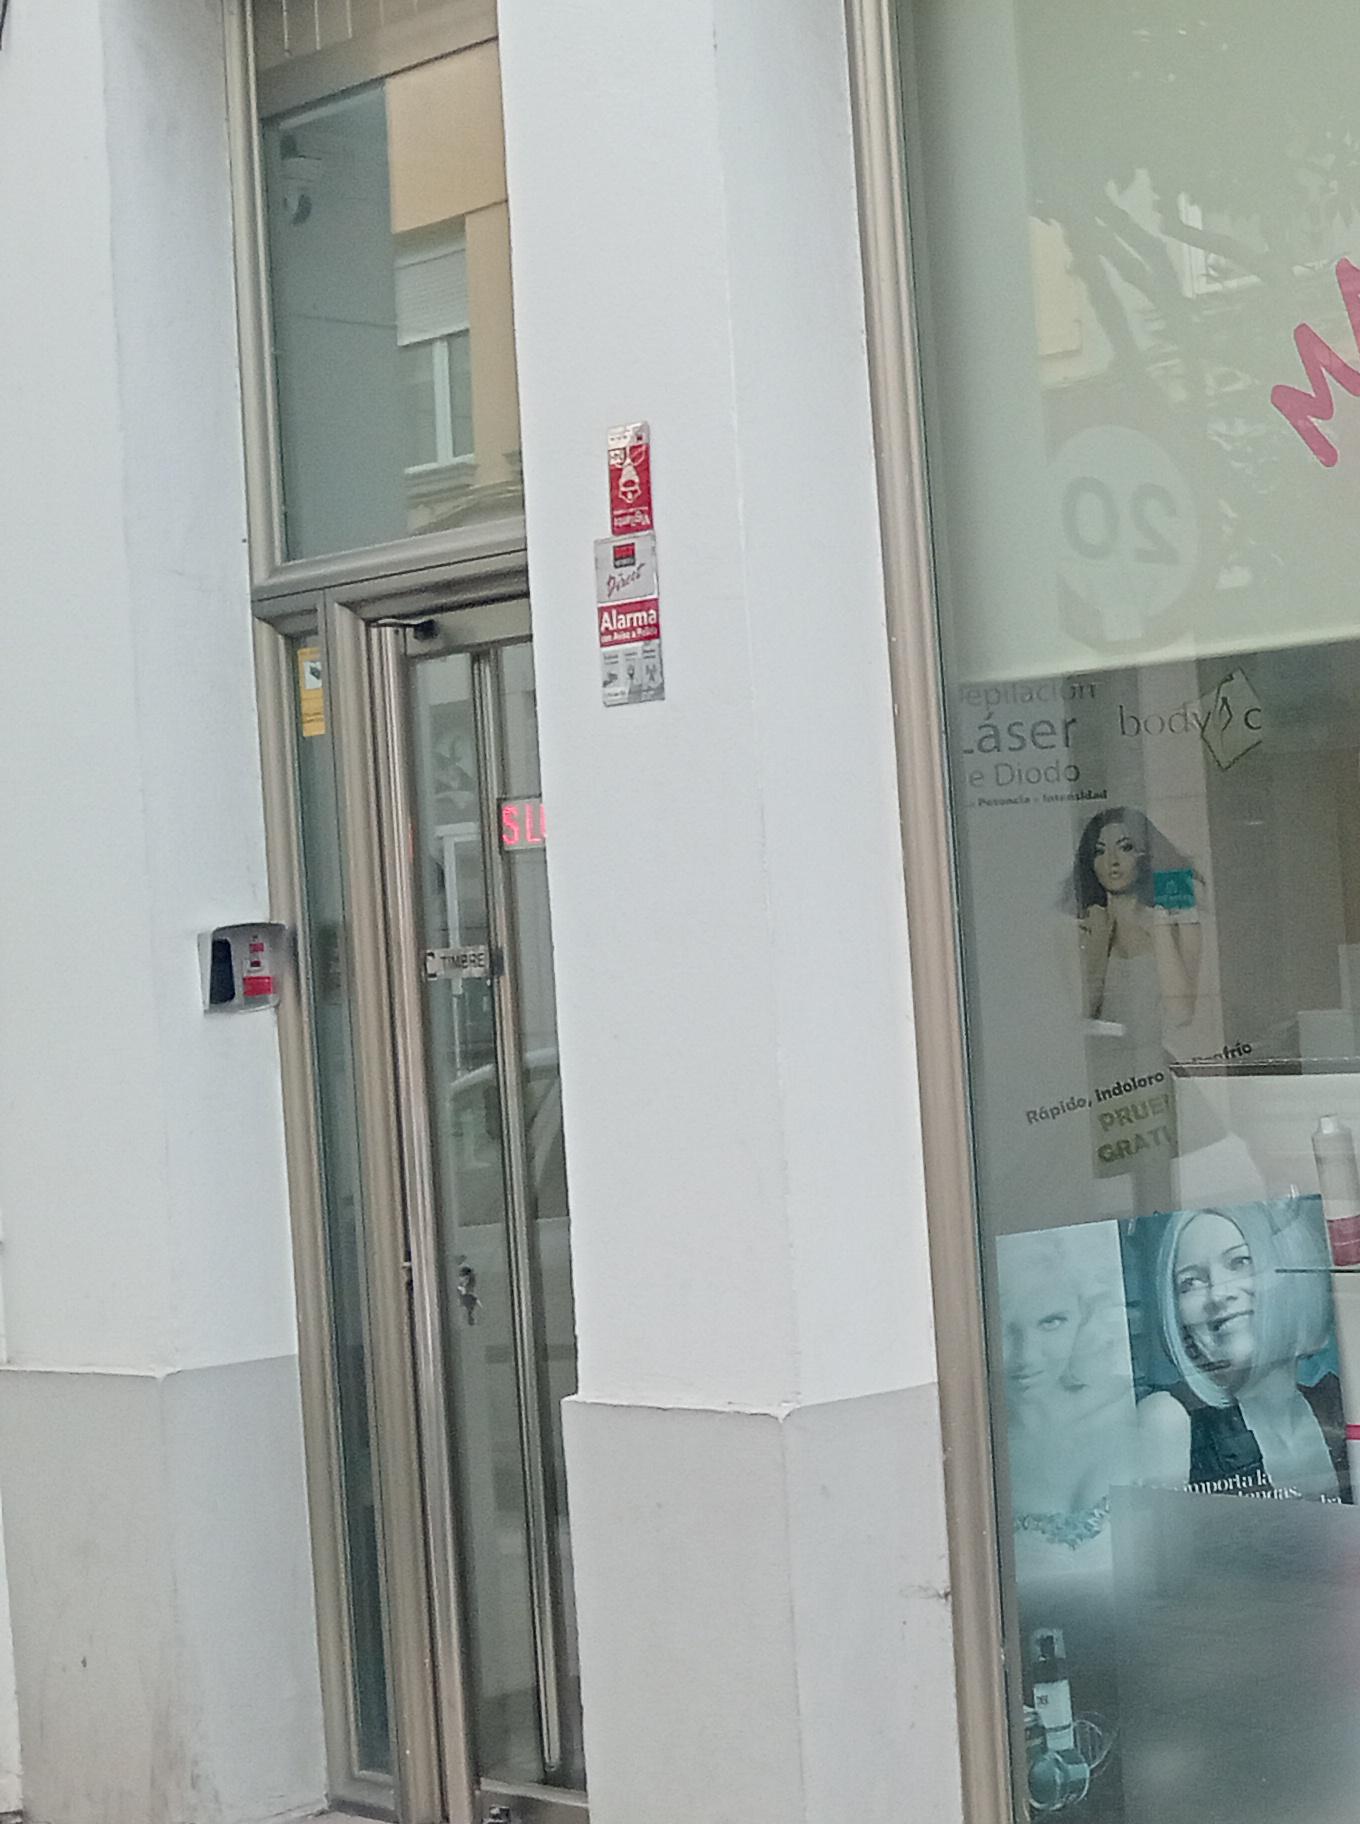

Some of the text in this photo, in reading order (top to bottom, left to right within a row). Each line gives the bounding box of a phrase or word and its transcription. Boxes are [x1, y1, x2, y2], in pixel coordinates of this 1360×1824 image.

[600, 608, 658, 634] Alarma
[962, 711, 1077, 755] áser
[994, 759, 1080, 787] Diodo
[439, 951, 487, 970] TIMBRE
[1025, 1096, 1093, 1126] Rápido,
[1099, 1093, 1174, 1132] PRUE
[1096, 1125, 1178, 1163] GRATI
